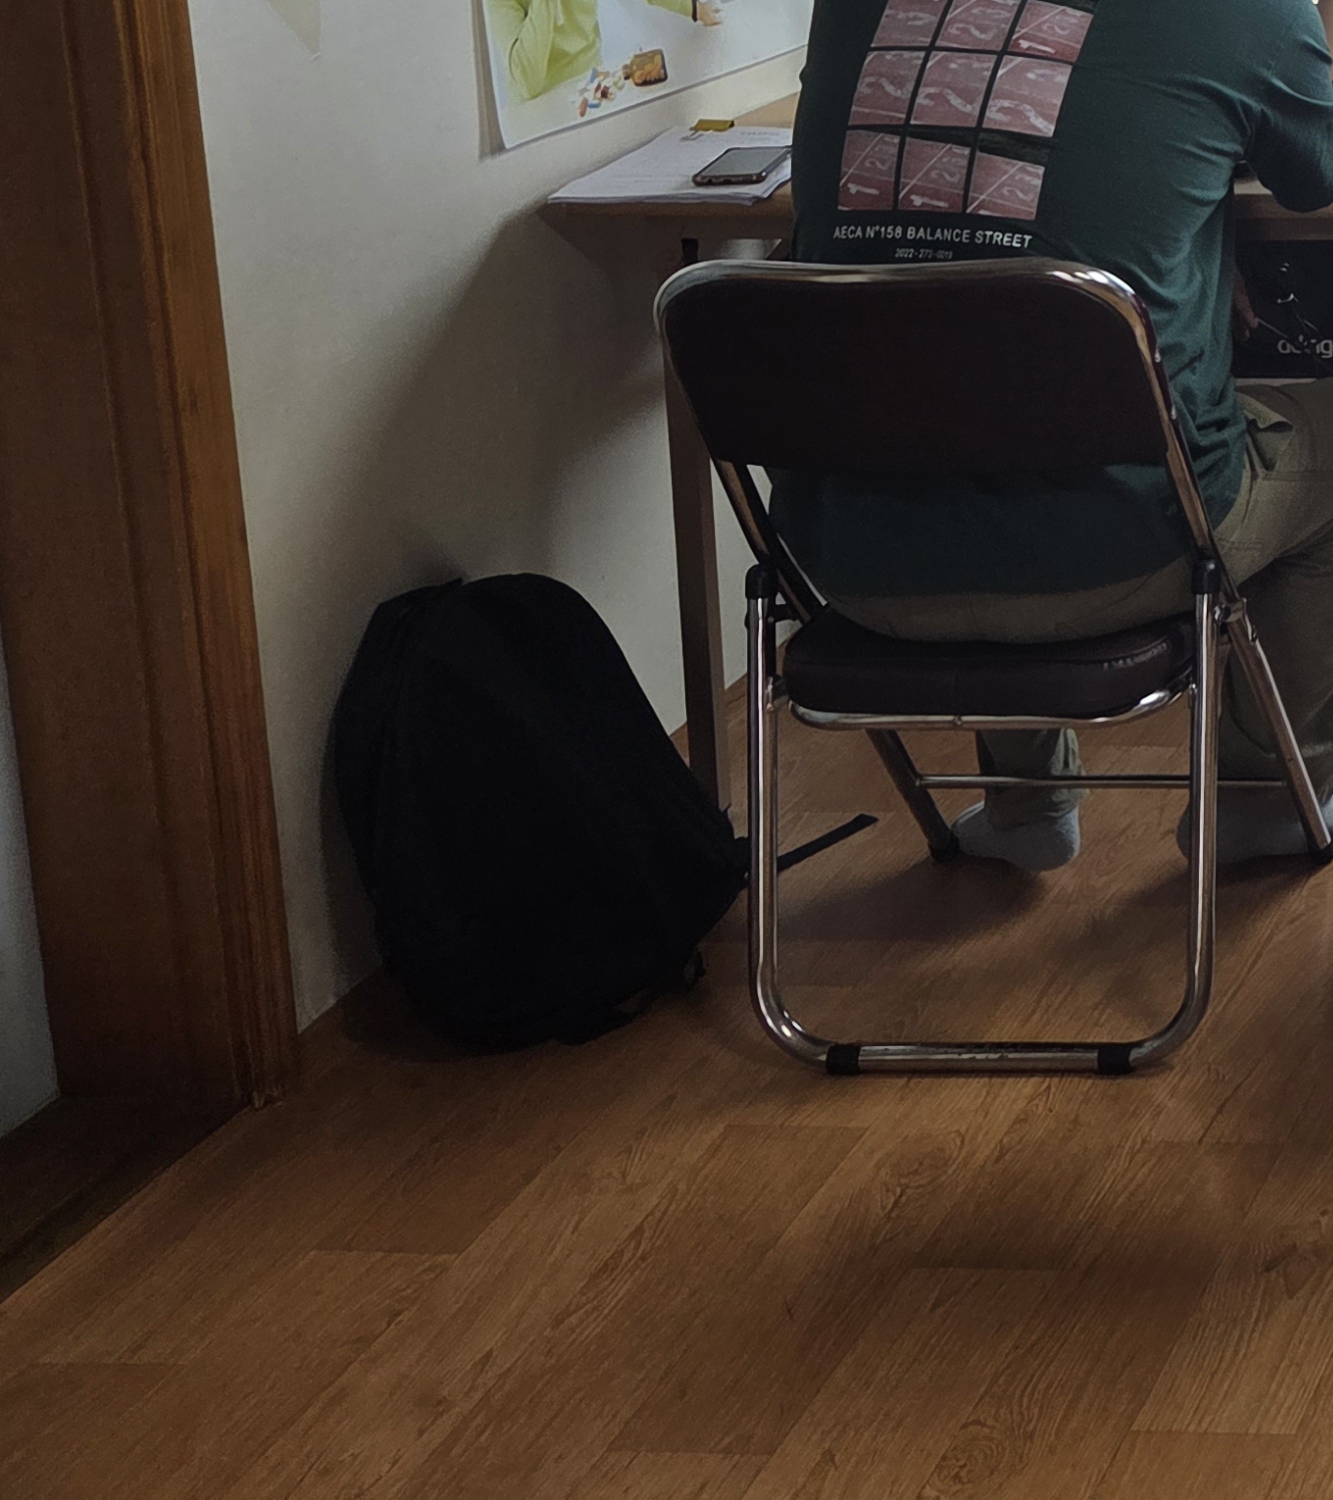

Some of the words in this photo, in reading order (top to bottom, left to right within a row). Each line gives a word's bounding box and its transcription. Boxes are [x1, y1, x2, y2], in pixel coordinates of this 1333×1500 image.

[833, 226, 862, 239] AECA
[906, 226, 970, 243] BALANCE
[974, 230, 1033, 249] STREET
